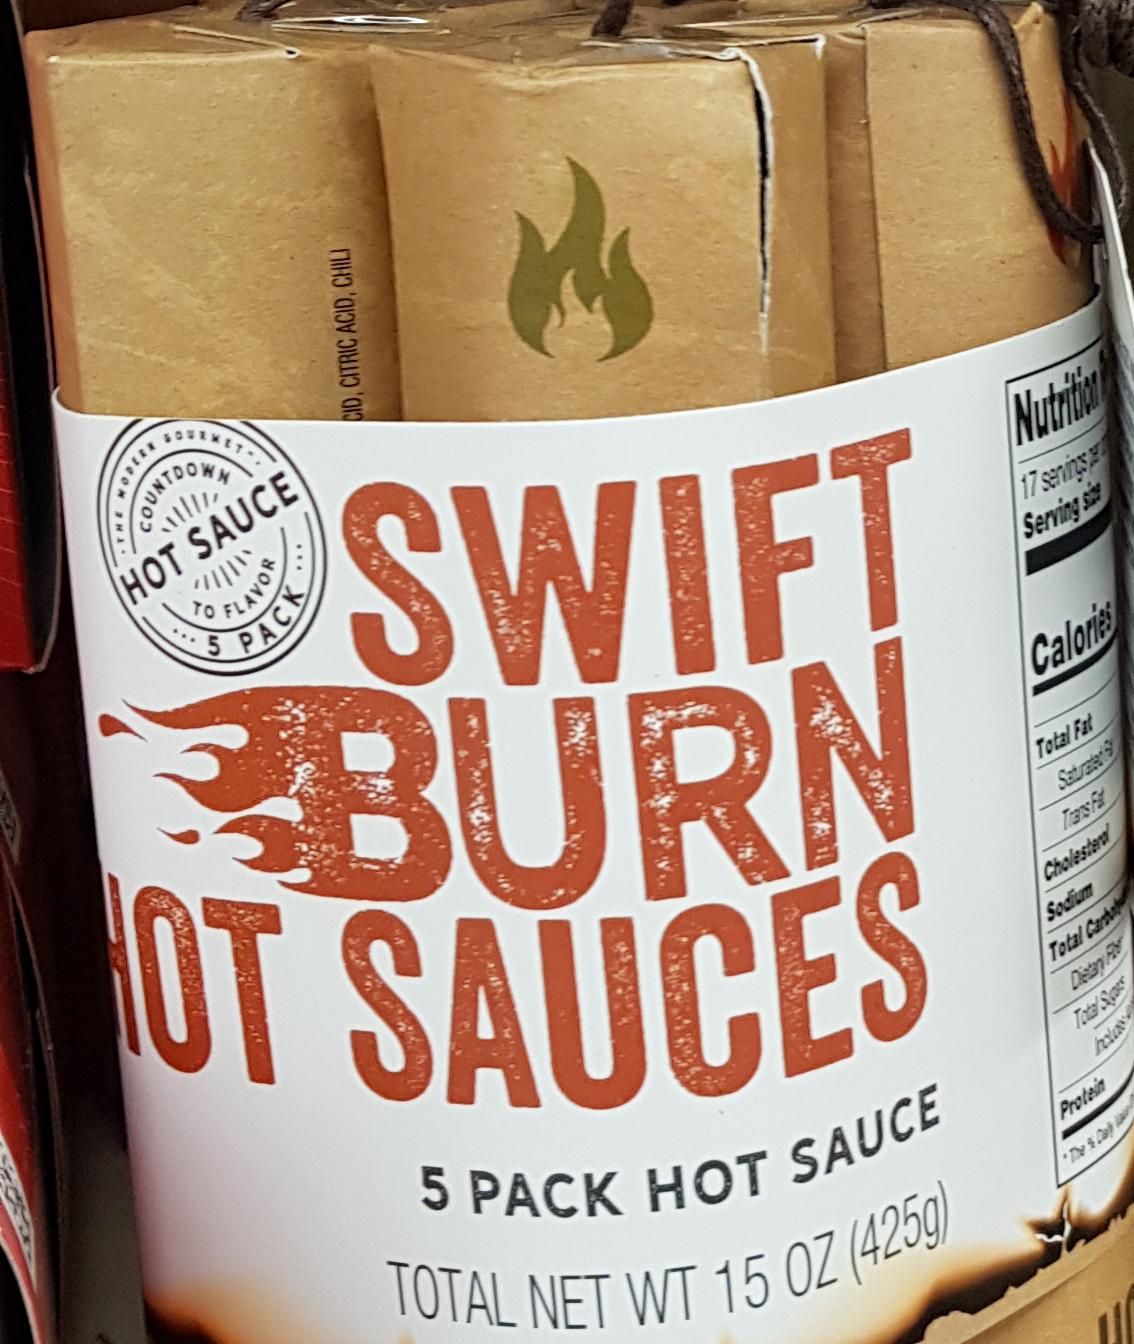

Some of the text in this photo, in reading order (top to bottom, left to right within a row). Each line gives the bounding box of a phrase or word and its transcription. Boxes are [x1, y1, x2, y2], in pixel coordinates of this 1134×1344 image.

[329, 248, 354, 288] CHILI
[337, 338, 361, 388] CITRIC
[341, 391, 365, 421] CID,
[1014, 365, 1099, 447] Nutrition
[140, 461, 230, 534] COUNTDOWN
[1020, 469, 1038, 500] 17
[120, 471, 299, 606] HOT SAUCE
[1023, 496, 1080, 540] Serving
[193, 557, 276, 619] TO FLAVOR
[341, 427, 913, 687] SWIFT
[207, 584, 305, 657] 5 PACK
[1031, 600, 1112, 676] Calories
[1036, 712, 1094, 759] Total Fat
[280, 636, 915, 911] BURN
[1044, 822, 1110, 882] Cholesterol
[1046, 883, 1094, 922] Sodium
[1049, 925, 1083, 962] Total
[106, 850, 928, 1110] HOT SAUCES
[1060, 1076, 1106, 1121] Protein
[421, 1082, 941, 1219] 5 PACK HOT SAUCE
[386, 1179, 950, 1330] TOTAL NET WT 15 OZ (425g)
